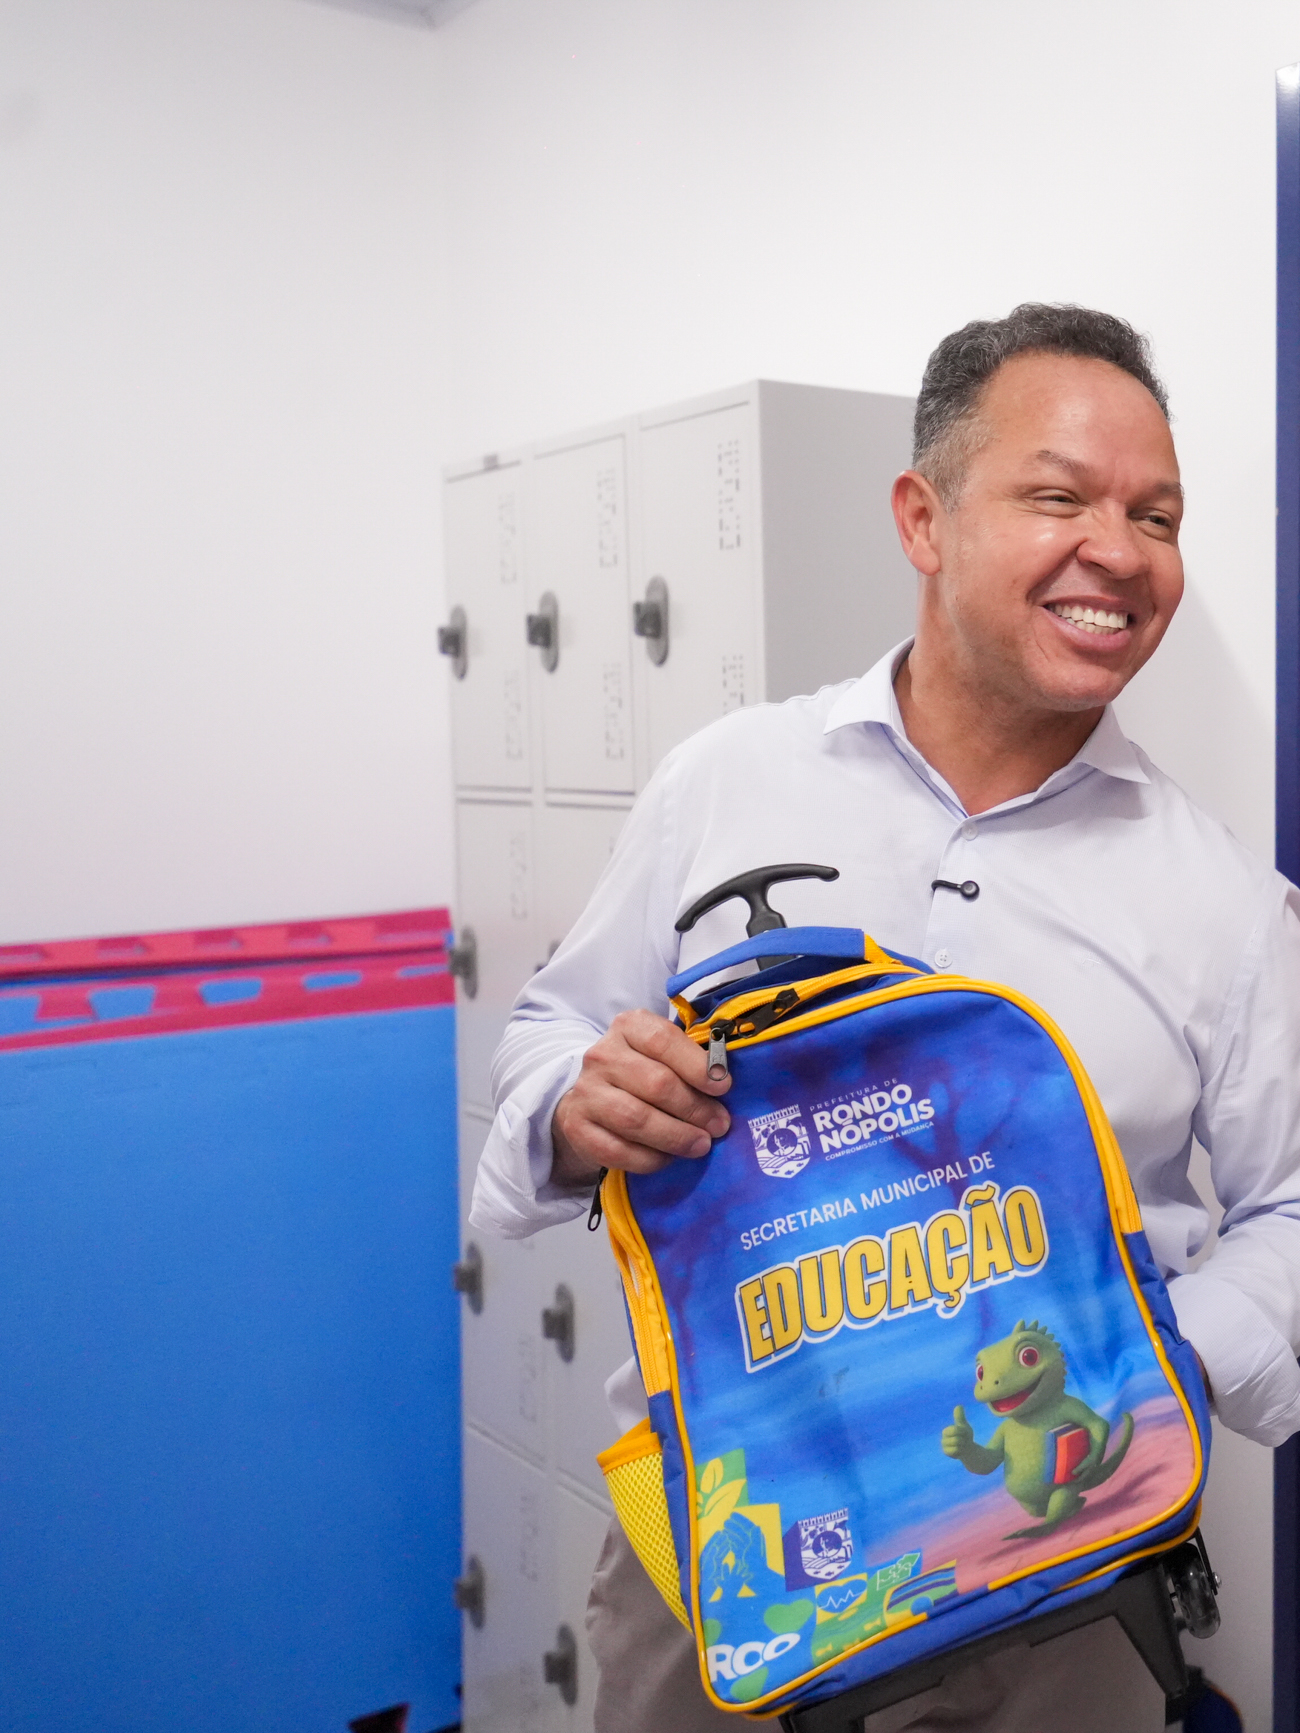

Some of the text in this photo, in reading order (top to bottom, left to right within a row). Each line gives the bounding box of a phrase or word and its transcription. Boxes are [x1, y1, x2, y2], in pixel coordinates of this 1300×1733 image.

[809, 1077, 898, 1112] PREFEITURA DE
[812, 1083, 912, 1132] RONDO
[819, 1098, 935, 1153] NÓPOLIS
[825, 1139, 878, 1161] COMPROMISSO
[879, 1133, 894, 1144] COM
[901, 1121, 935, 1136] MUDANÇA
[740, 1151, 995, 1250] SECRETARIA MUNICIPAL DE
[738, 1182, 1048, 1366] EDUCAÇÃO
